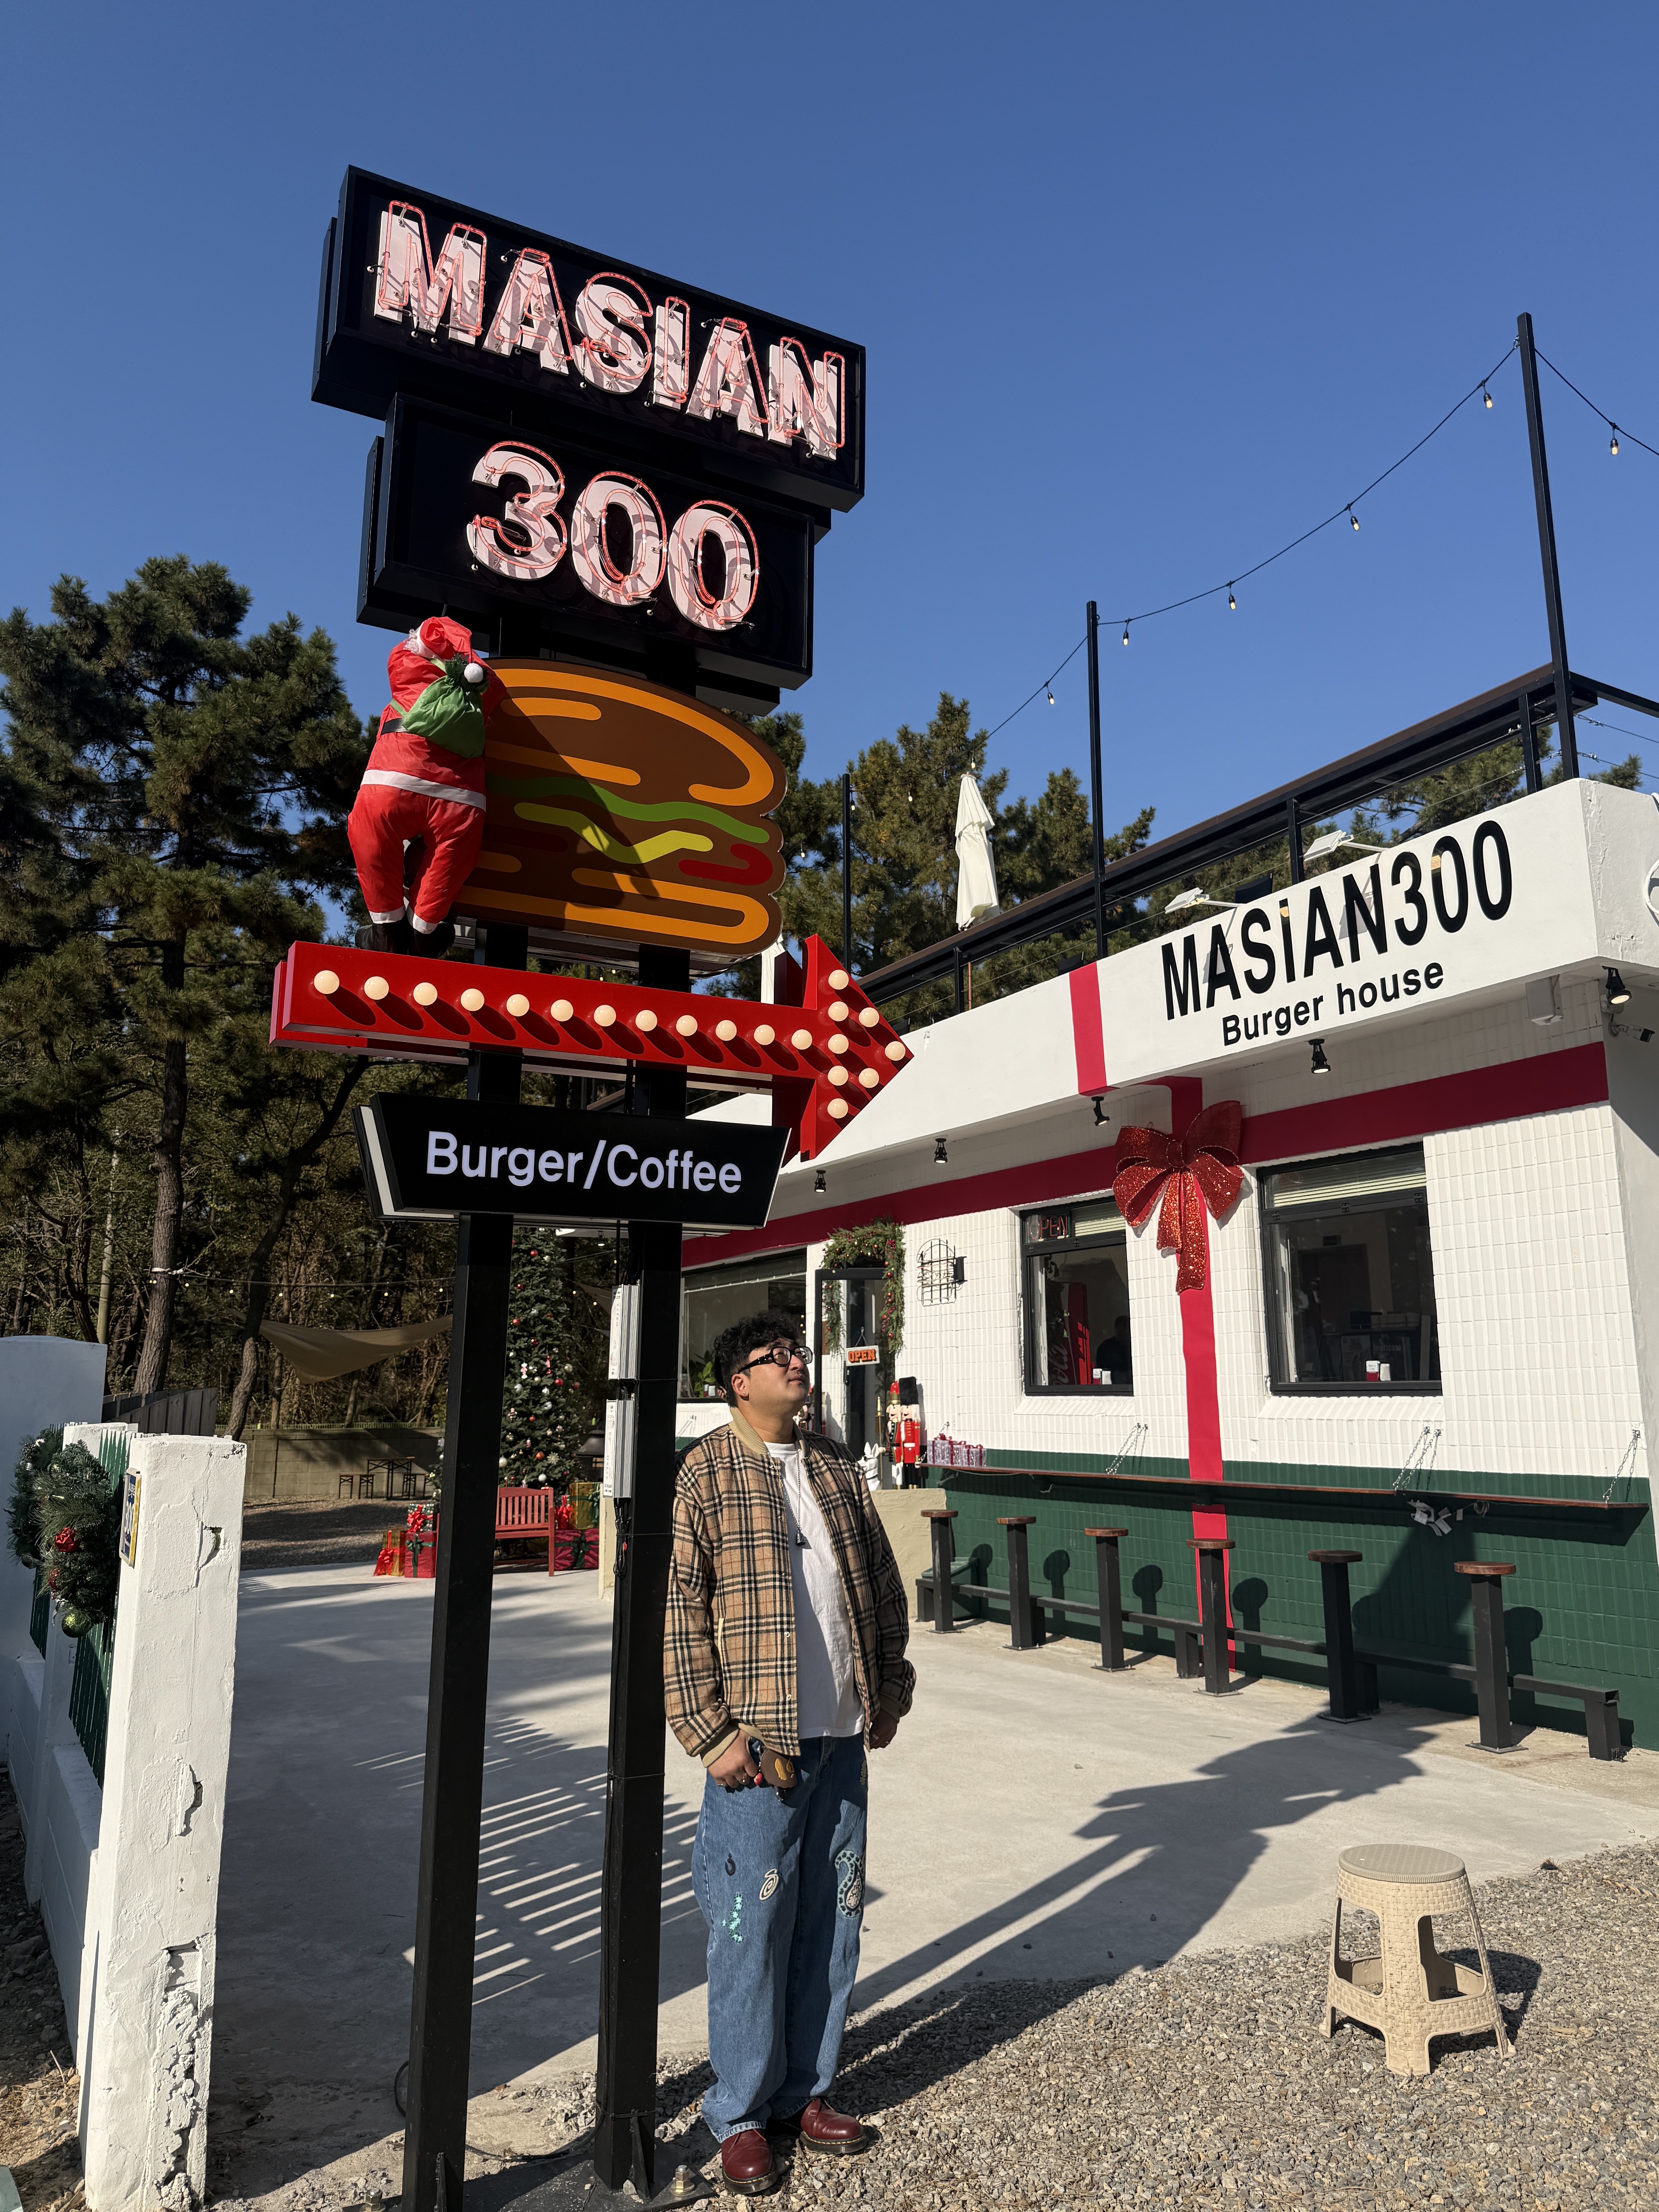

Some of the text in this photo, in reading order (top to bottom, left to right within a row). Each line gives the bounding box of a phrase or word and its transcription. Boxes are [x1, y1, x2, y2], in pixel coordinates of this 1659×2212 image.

[373, 201, 845, 461] MASIAN
[466, 441, 760, 631] 300
[1161, 820, 1512, 1020] MASIAN300
[1222, 962, 1444, 1047] Burger house
[426, 1130, 742, 1194] Burger/Coffee
[1029, 1215, 1068, 1240] OPEN
[848, 1348, 876, 1363] OPEN
